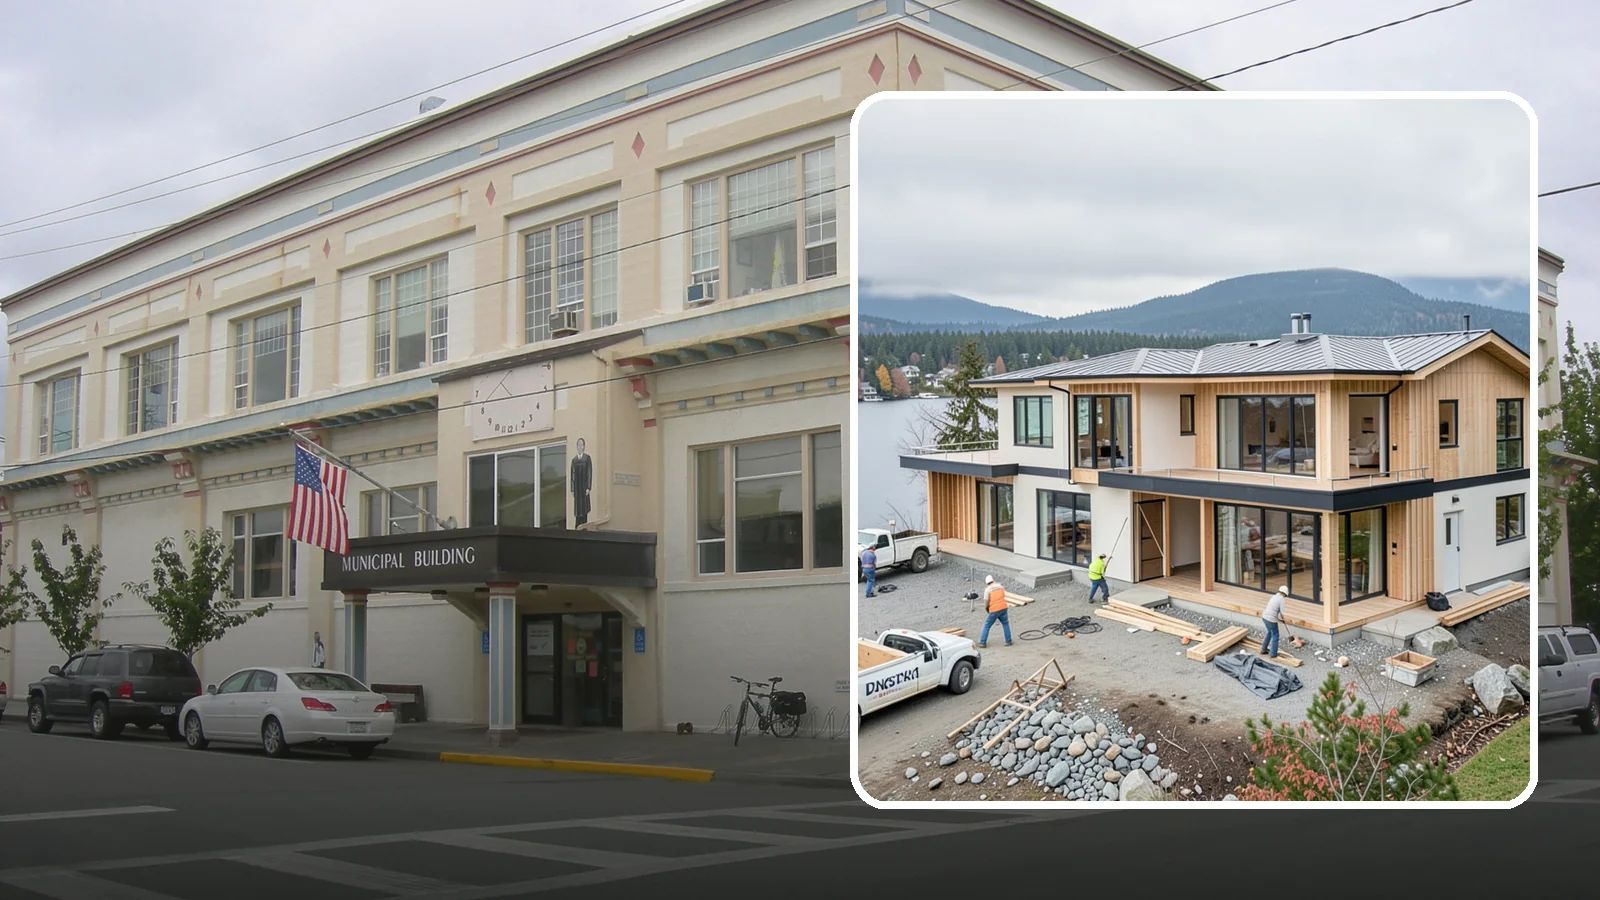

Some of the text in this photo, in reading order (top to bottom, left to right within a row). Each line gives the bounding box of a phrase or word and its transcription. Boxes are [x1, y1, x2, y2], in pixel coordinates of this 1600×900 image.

[480, 406, 485, 415] 8
[488, 418, 492, 426] 9
[529, 414, 533, 422] 3
[342, 546, 475, 572] MUNICIPAL BUILDING
